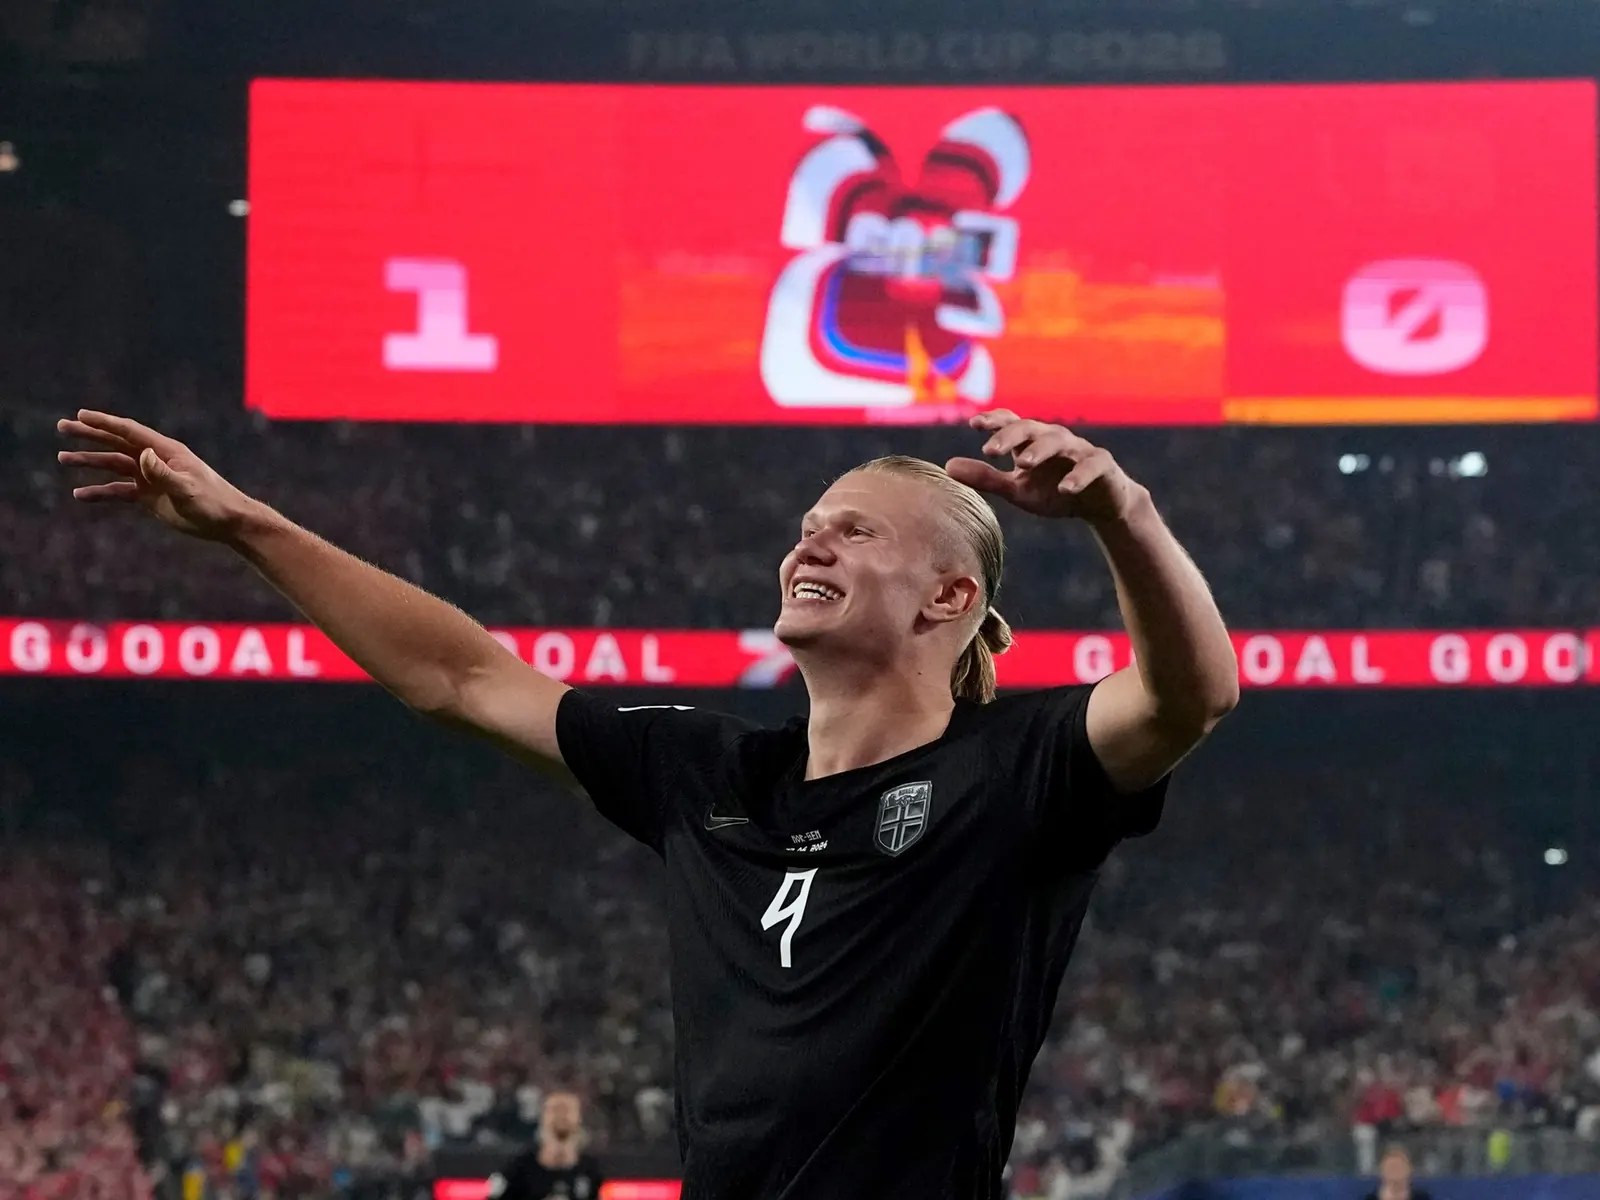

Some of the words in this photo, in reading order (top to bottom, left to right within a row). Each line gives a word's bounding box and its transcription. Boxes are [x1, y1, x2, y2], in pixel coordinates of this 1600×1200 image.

[382, 257, 499, 372] 1
[1340, 257, 1489, 376] 0
[10, 621, 320, 677] GOOOAL
[490, 631, 676, 683] OAL
[1073, 635, 1384, 685] GOAL
[761, 867, 819, 968] 9
